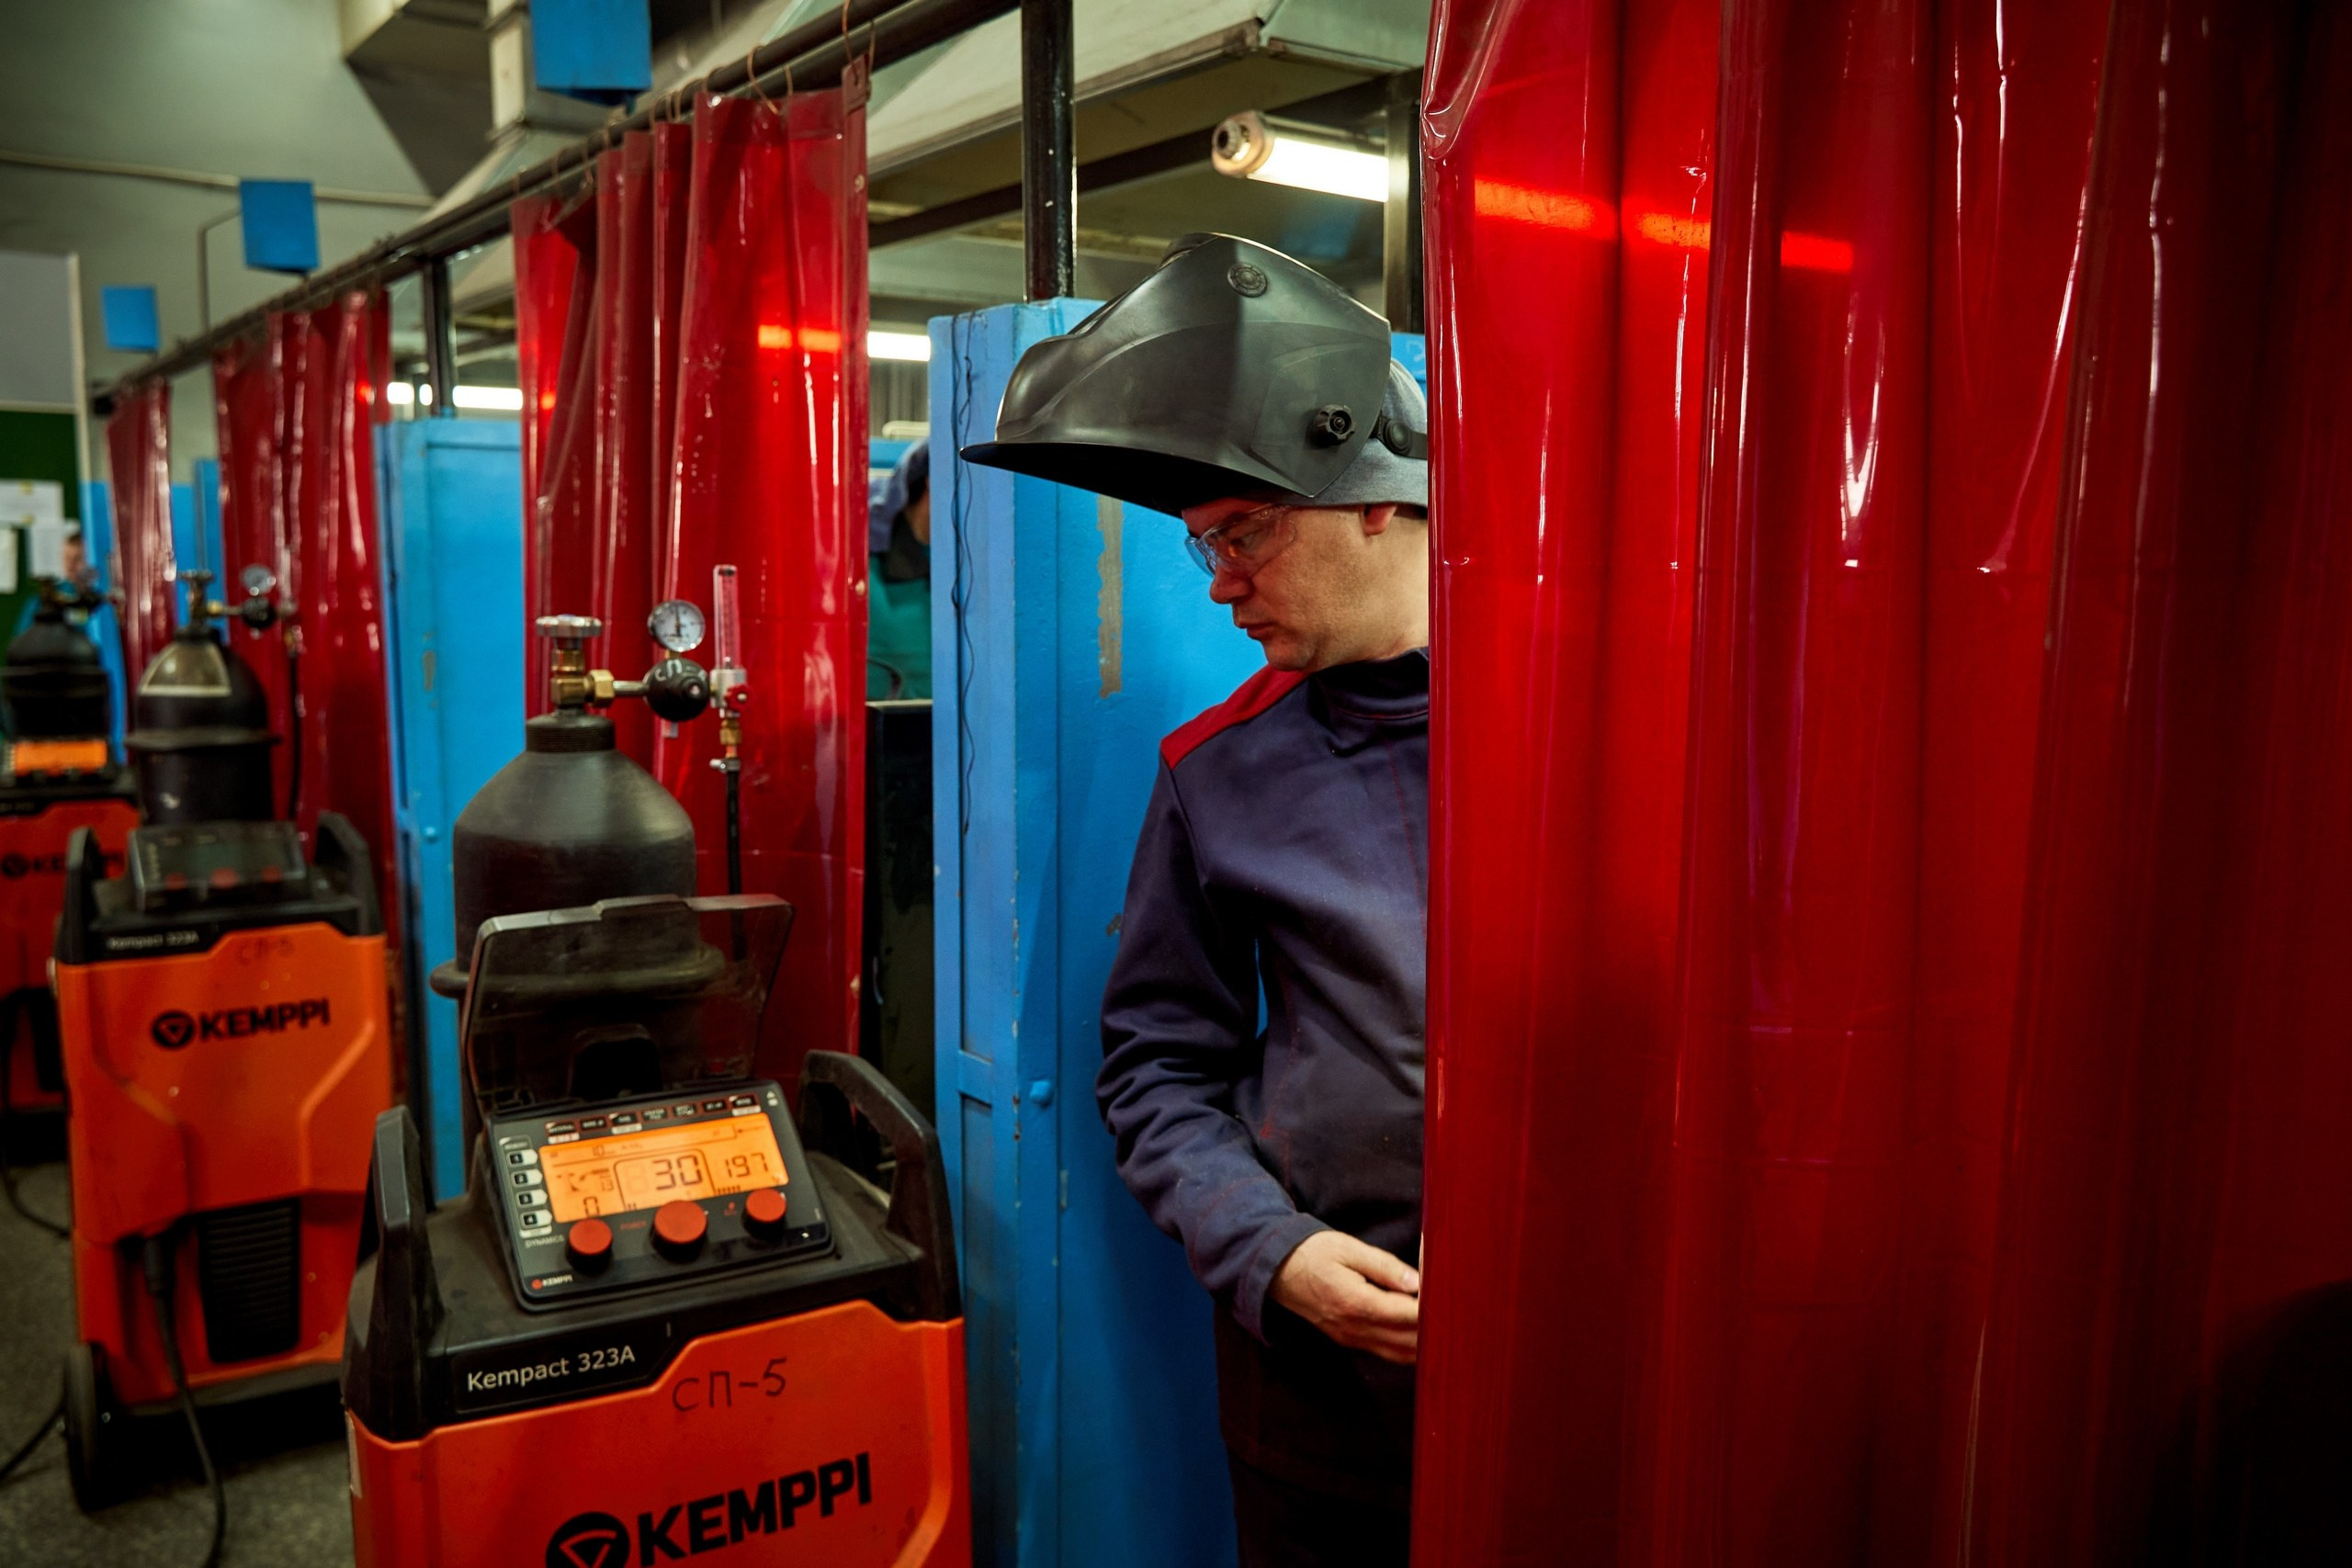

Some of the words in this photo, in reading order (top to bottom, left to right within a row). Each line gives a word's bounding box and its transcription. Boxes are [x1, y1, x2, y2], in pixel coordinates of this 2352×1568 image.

[199, 998, 331, 1042] KEMPPI
[652, 1155, 703, 1190] 30
[725, 1152, 769, 1179] 197
[525, 1235, 565, 1249] DYNAMICS
[467, 1359, 570, 1392] Kempact
[578, 1345, 636, 1372] 323A
[638, 1451, 872, 1567] KEMPPI
